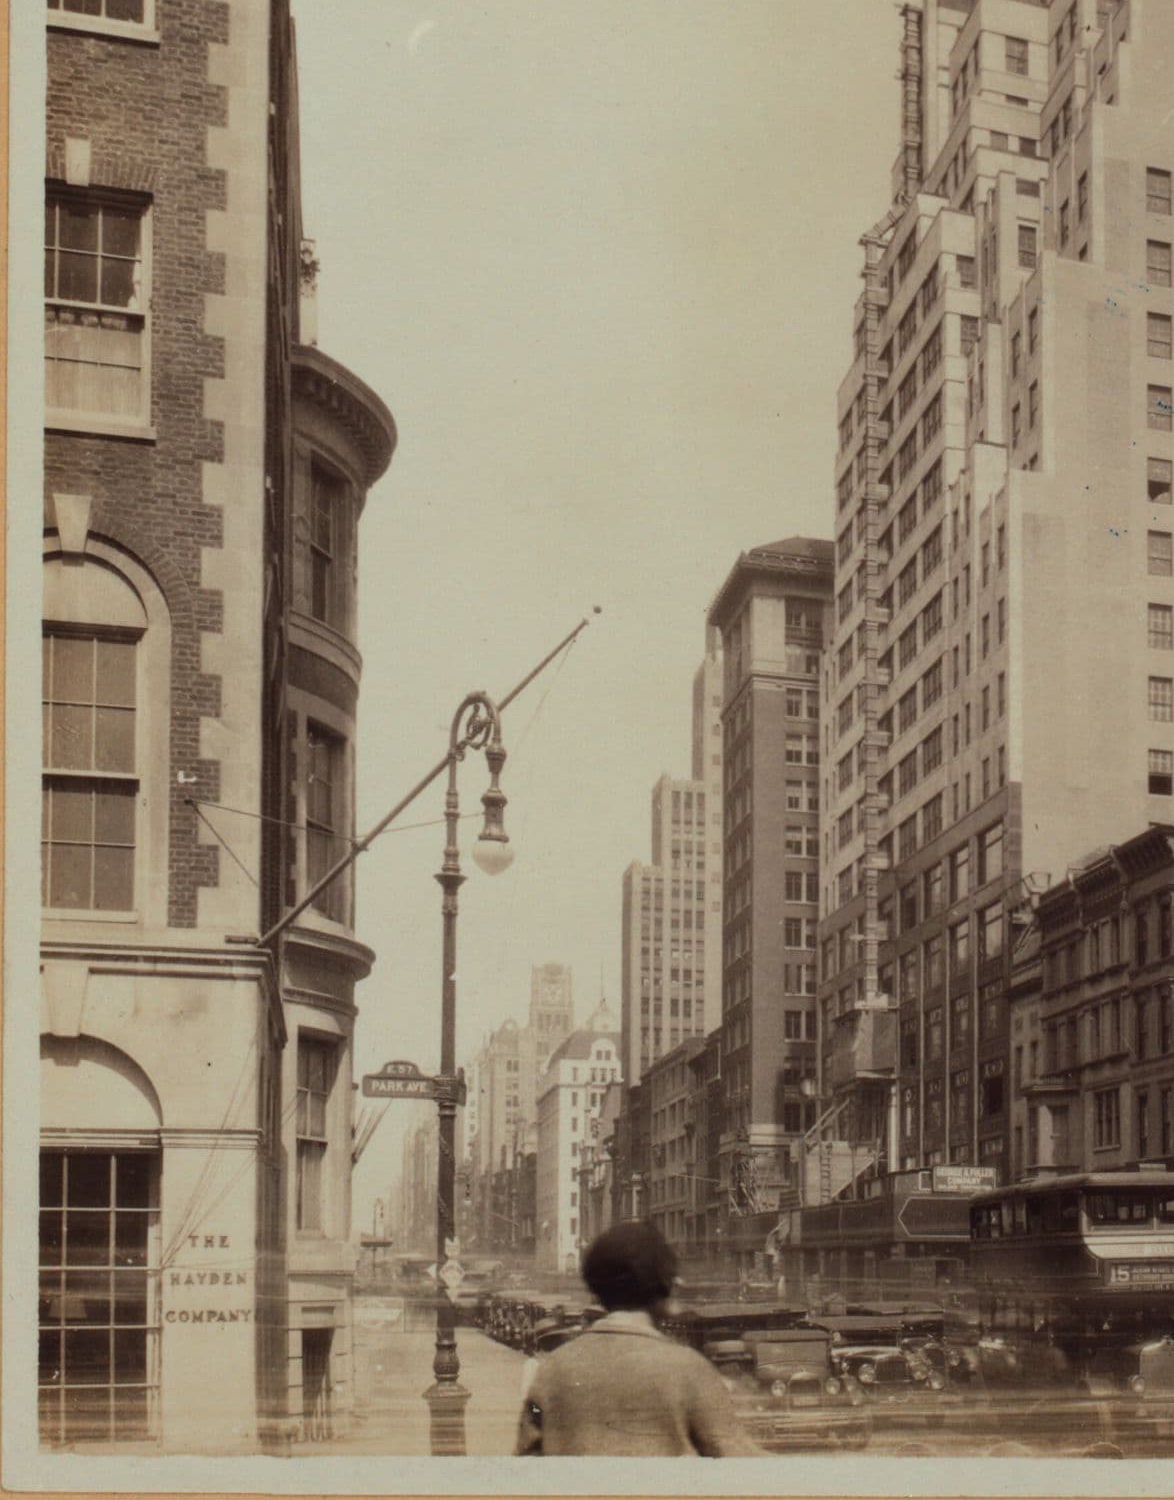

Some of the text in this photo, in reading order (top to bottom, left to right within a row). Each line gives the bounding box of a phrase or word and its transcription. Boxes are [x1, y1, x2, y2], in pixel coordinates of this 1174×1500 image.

[371, 1080, 404, 1092] PARK
[187, 1235, 231, 1248] THE
[169, 1272, 248, 1286] HAYDEN
[1110, 1264, 1131, 1284] 15
[165, 1309, 252, 1324] COMPANY
